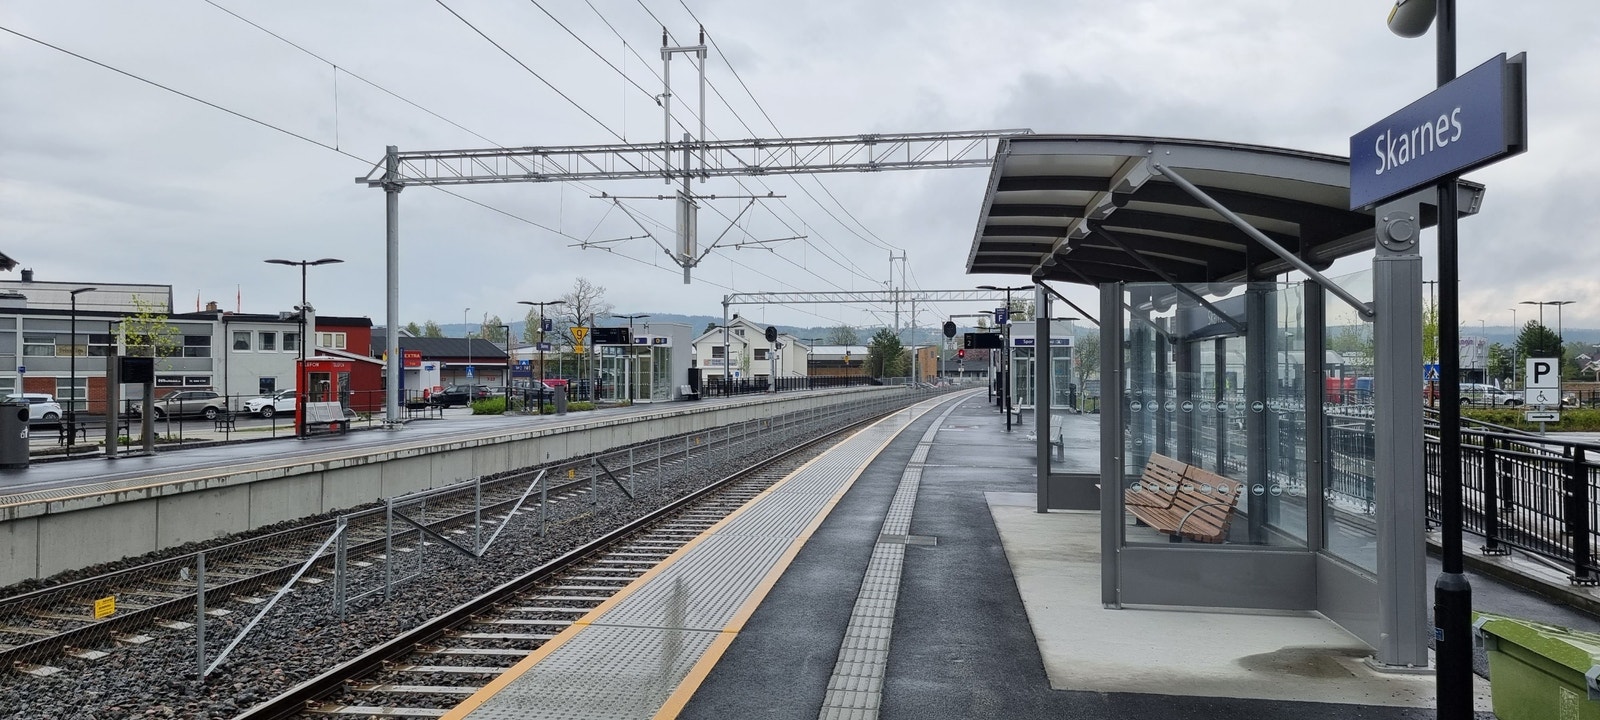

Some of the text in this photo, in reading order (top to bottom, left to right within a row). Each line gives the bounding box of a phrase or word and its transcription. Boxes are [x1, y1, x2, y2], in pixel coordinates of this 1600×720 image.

[1375, 107, 1462, 175] Skarnes
[576, 329, 583, 340] 9
[1534, 362, 1551, 384] P
